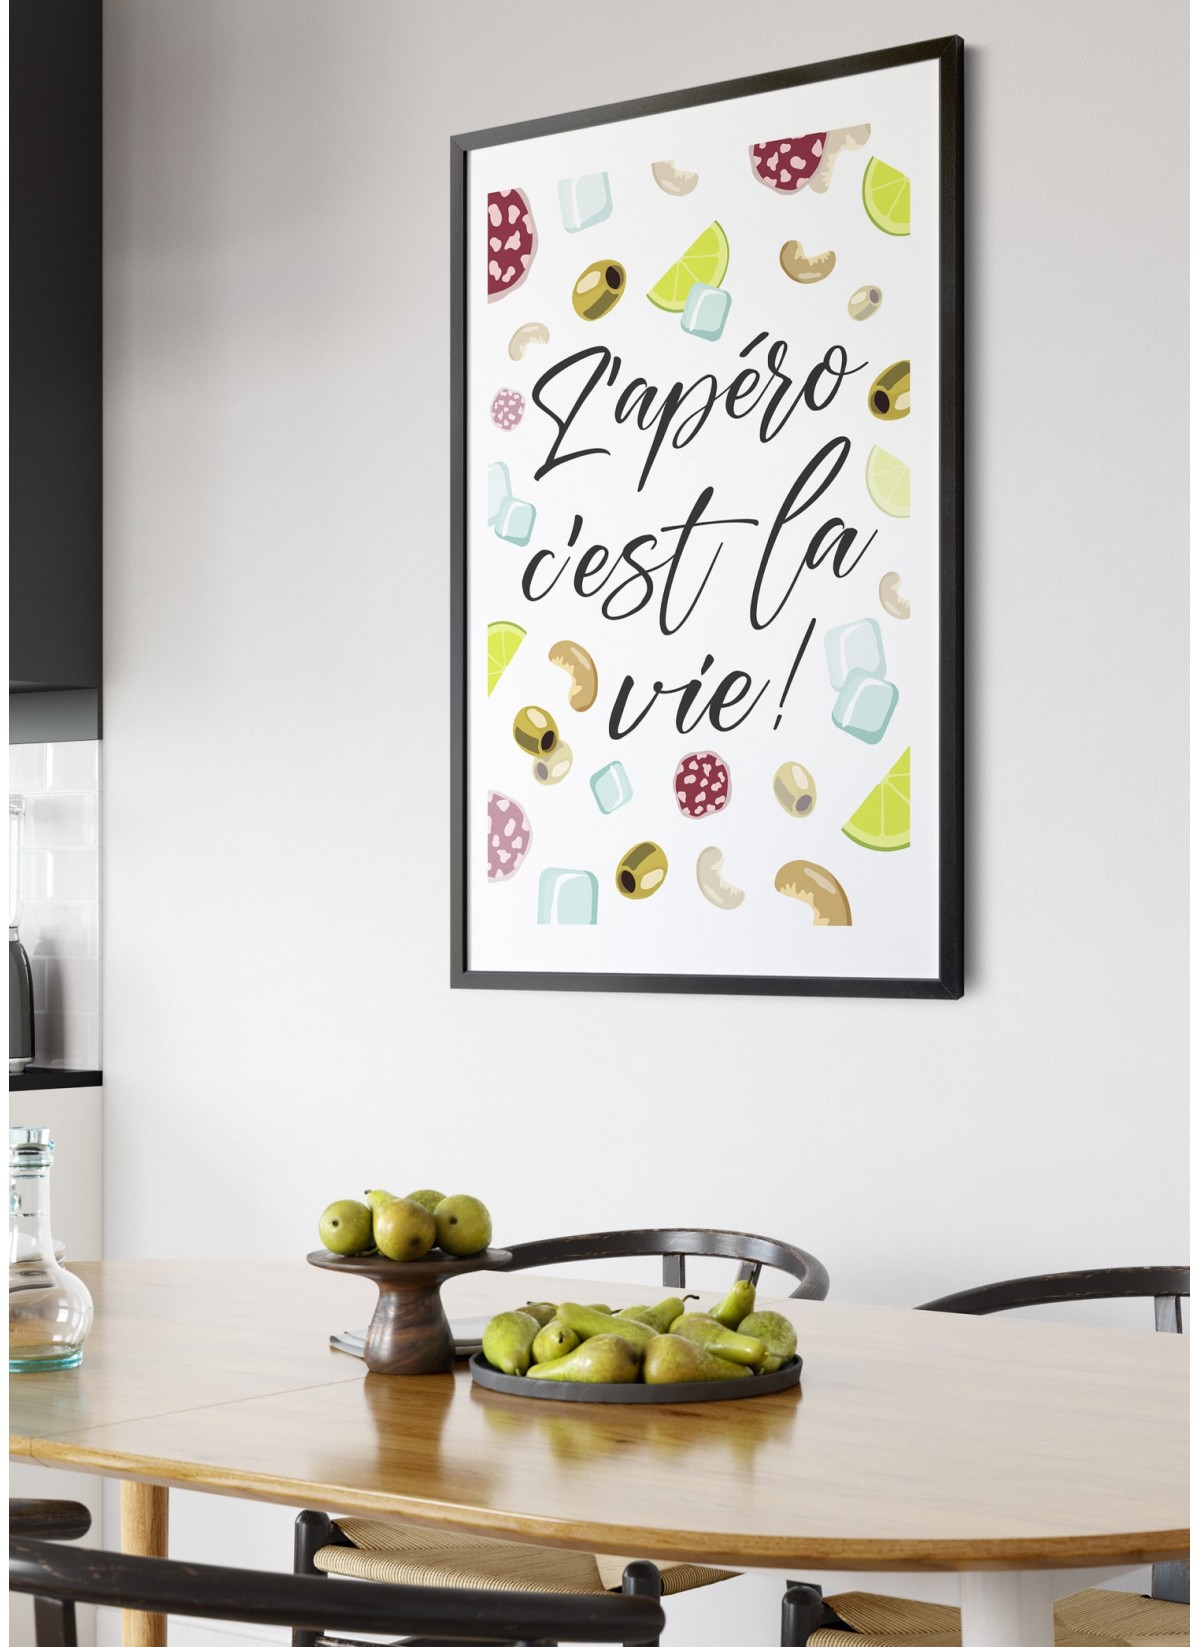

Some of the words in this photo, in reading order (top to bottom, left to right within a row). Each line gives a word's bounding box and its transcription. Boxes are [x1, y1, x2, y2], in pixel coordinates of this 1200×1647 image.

[531, 331, 869, 492] L'apéro
[522, 486, 758, 635] c'est
[750, 436, 878, 630] la
